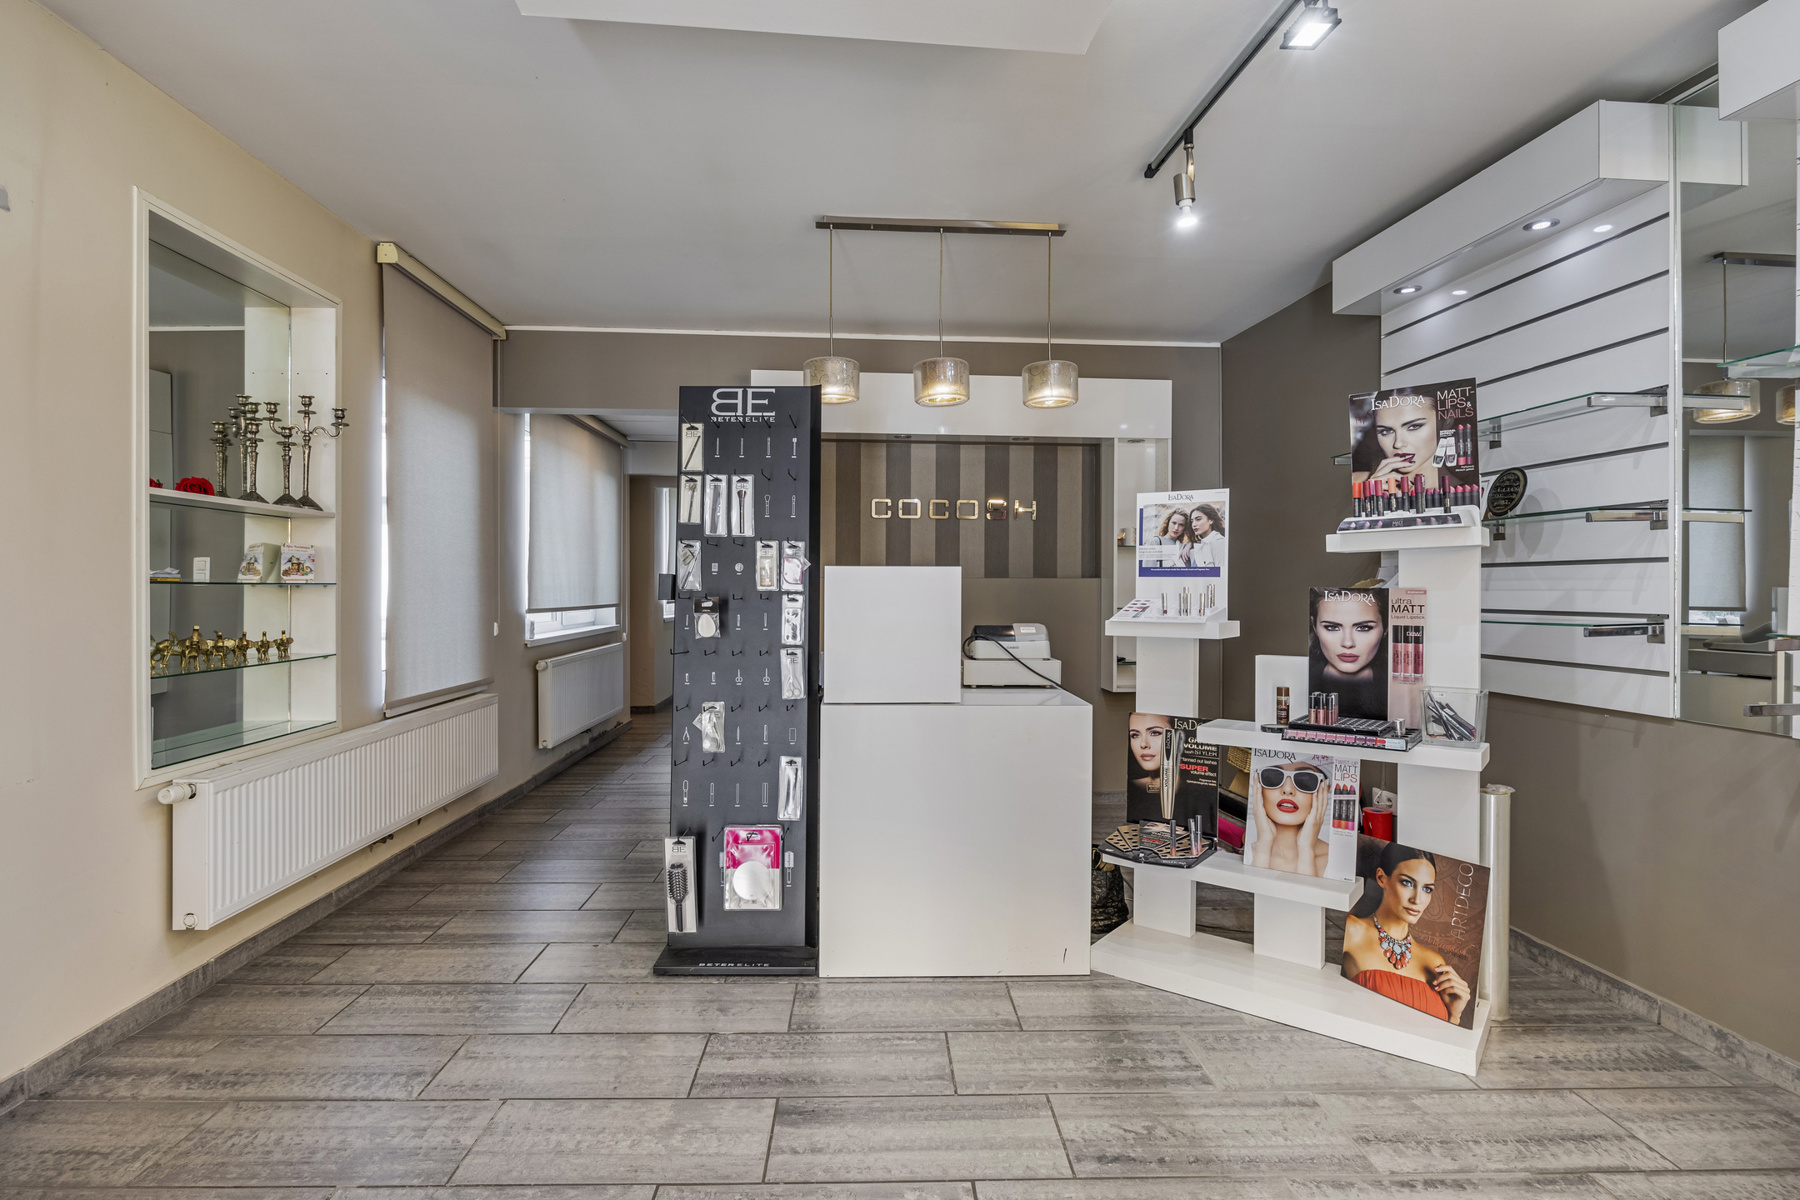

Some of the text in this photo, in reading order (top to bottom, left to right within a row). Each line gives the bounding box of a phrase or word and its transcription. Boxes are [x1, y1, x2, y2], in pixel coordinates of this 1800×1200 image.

[1437, 386, 1475, 400] MATT-
[711, 388, 776, 416] BE
[1438, 407, 1474, 420] NAILS
[871, 498, 1037, 520] COCOSH
[1391, 597, 1412, 605] ultra
[1391, 604, 1425, 613] MATT
[1174, 718, 1204, 730] ISAD
[1183, 743, 1218, 751] VOLUME
[1180, 763, 1209, 772] SUPER
[1334, 764, 1359, 774] MATT
[1334, 772, 1358, 783] LIPS
[1451, 863, 1475, 940] ARTDECO
